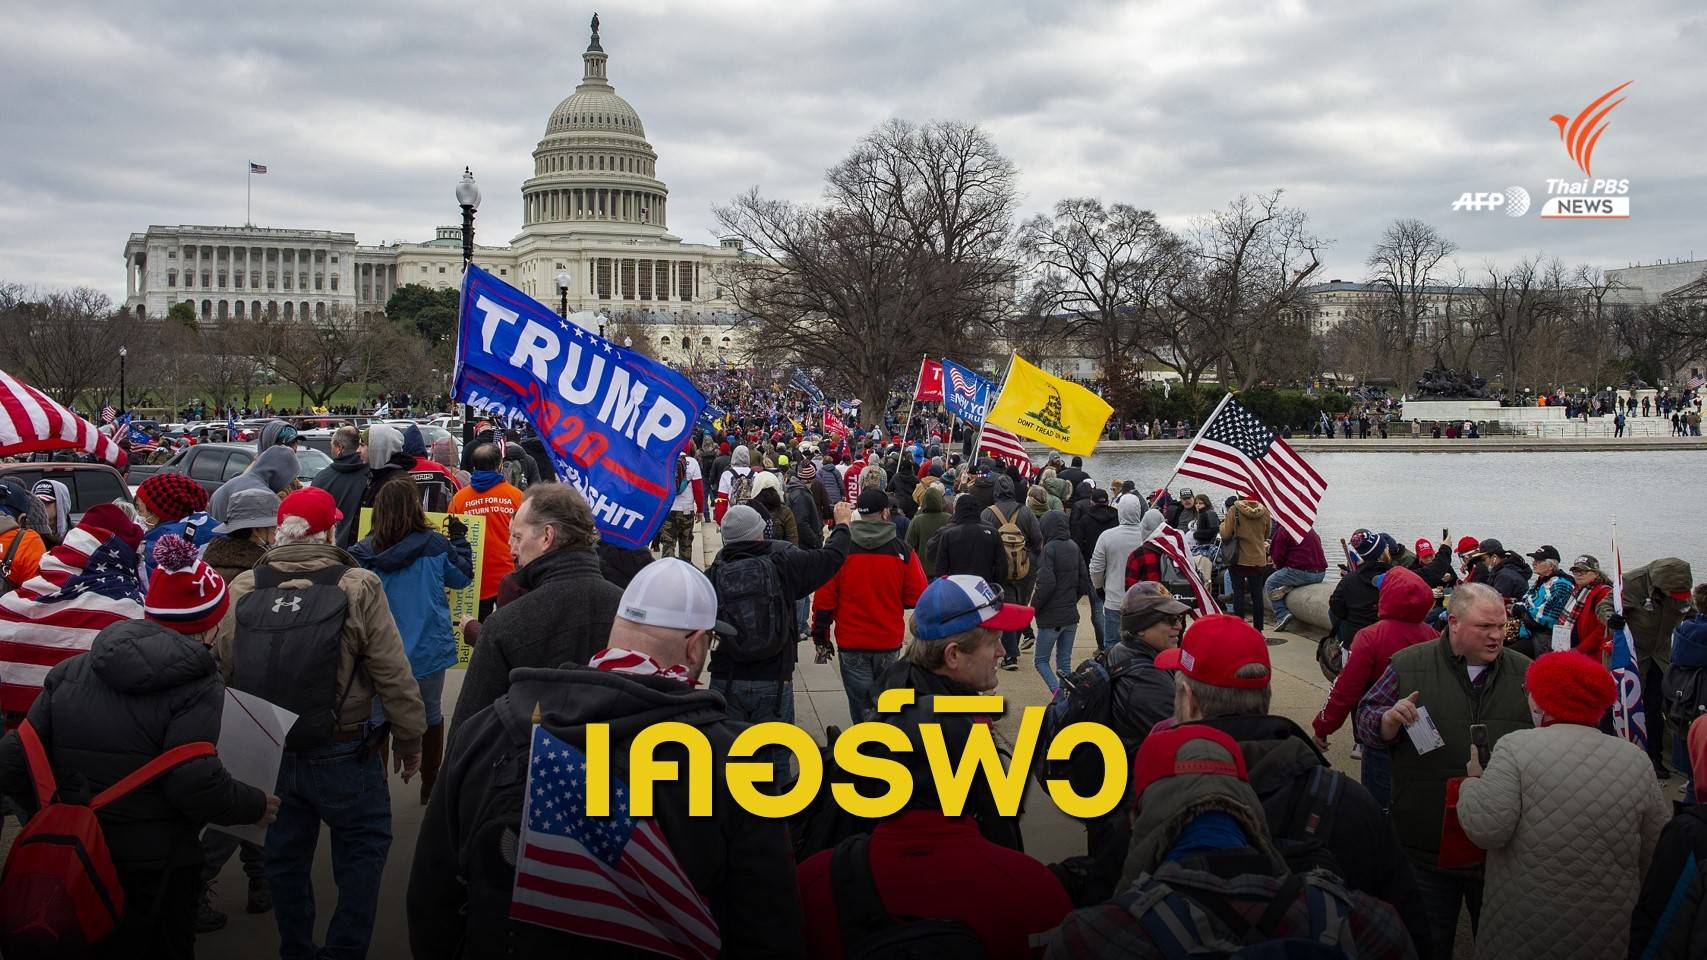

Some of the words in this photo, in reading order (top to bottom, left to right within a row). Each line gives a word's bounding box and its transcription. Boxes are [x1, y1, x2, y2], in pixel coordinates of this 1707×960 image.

[475, 294, 687, 450] TRUMP
[1017, 418, 1034, 429] DONT
[1036, 426, 1054, 437] TREAD
[465, 498, 484, 507] FIGHT
